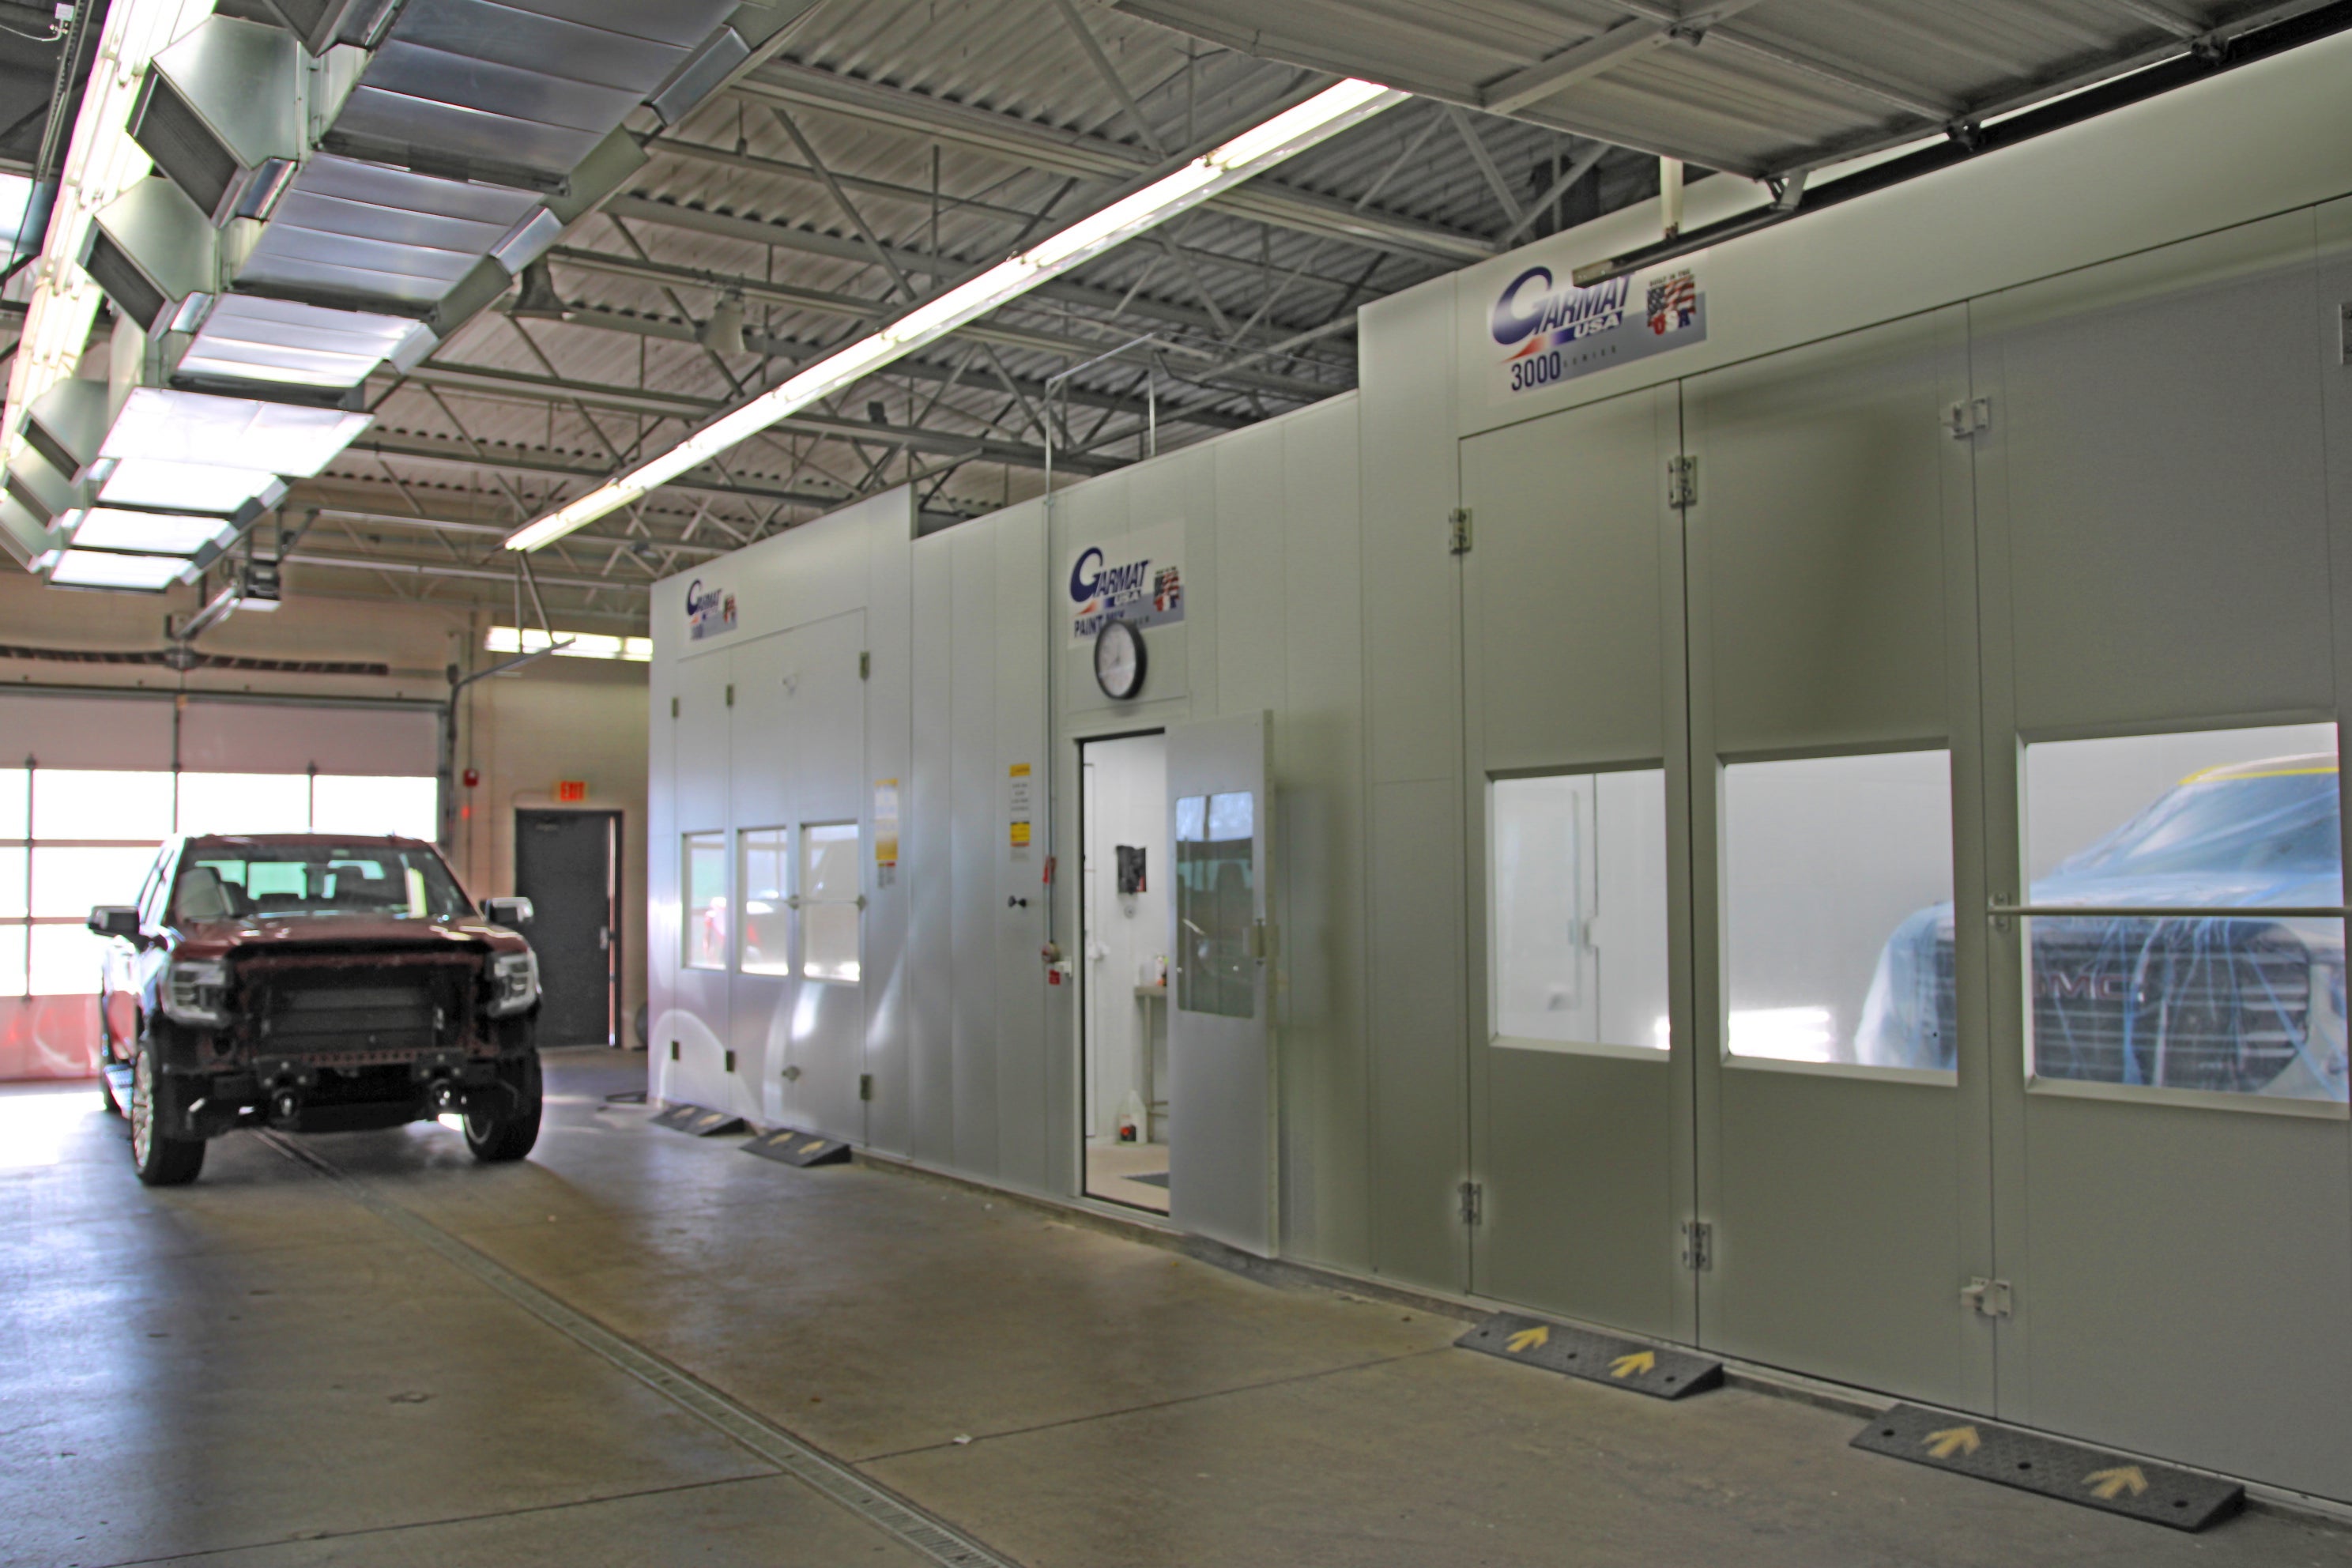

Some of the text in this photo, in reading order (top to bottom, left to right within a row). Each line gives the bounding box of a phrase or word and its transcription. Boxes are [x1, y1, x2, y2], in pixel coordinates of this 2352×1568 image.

[1492, 266, 1631, 345] GARMAT
[1574, 315, 1621, 338] USA
[1652, 310, 1691, 335] USA
[1511, 351, 1561, 391] 3000
[1070, 546, 1150, 603] GARMAT
[1074, 615, 1102, 638] PAINT
[560, 781, 585, 801] EXIT
